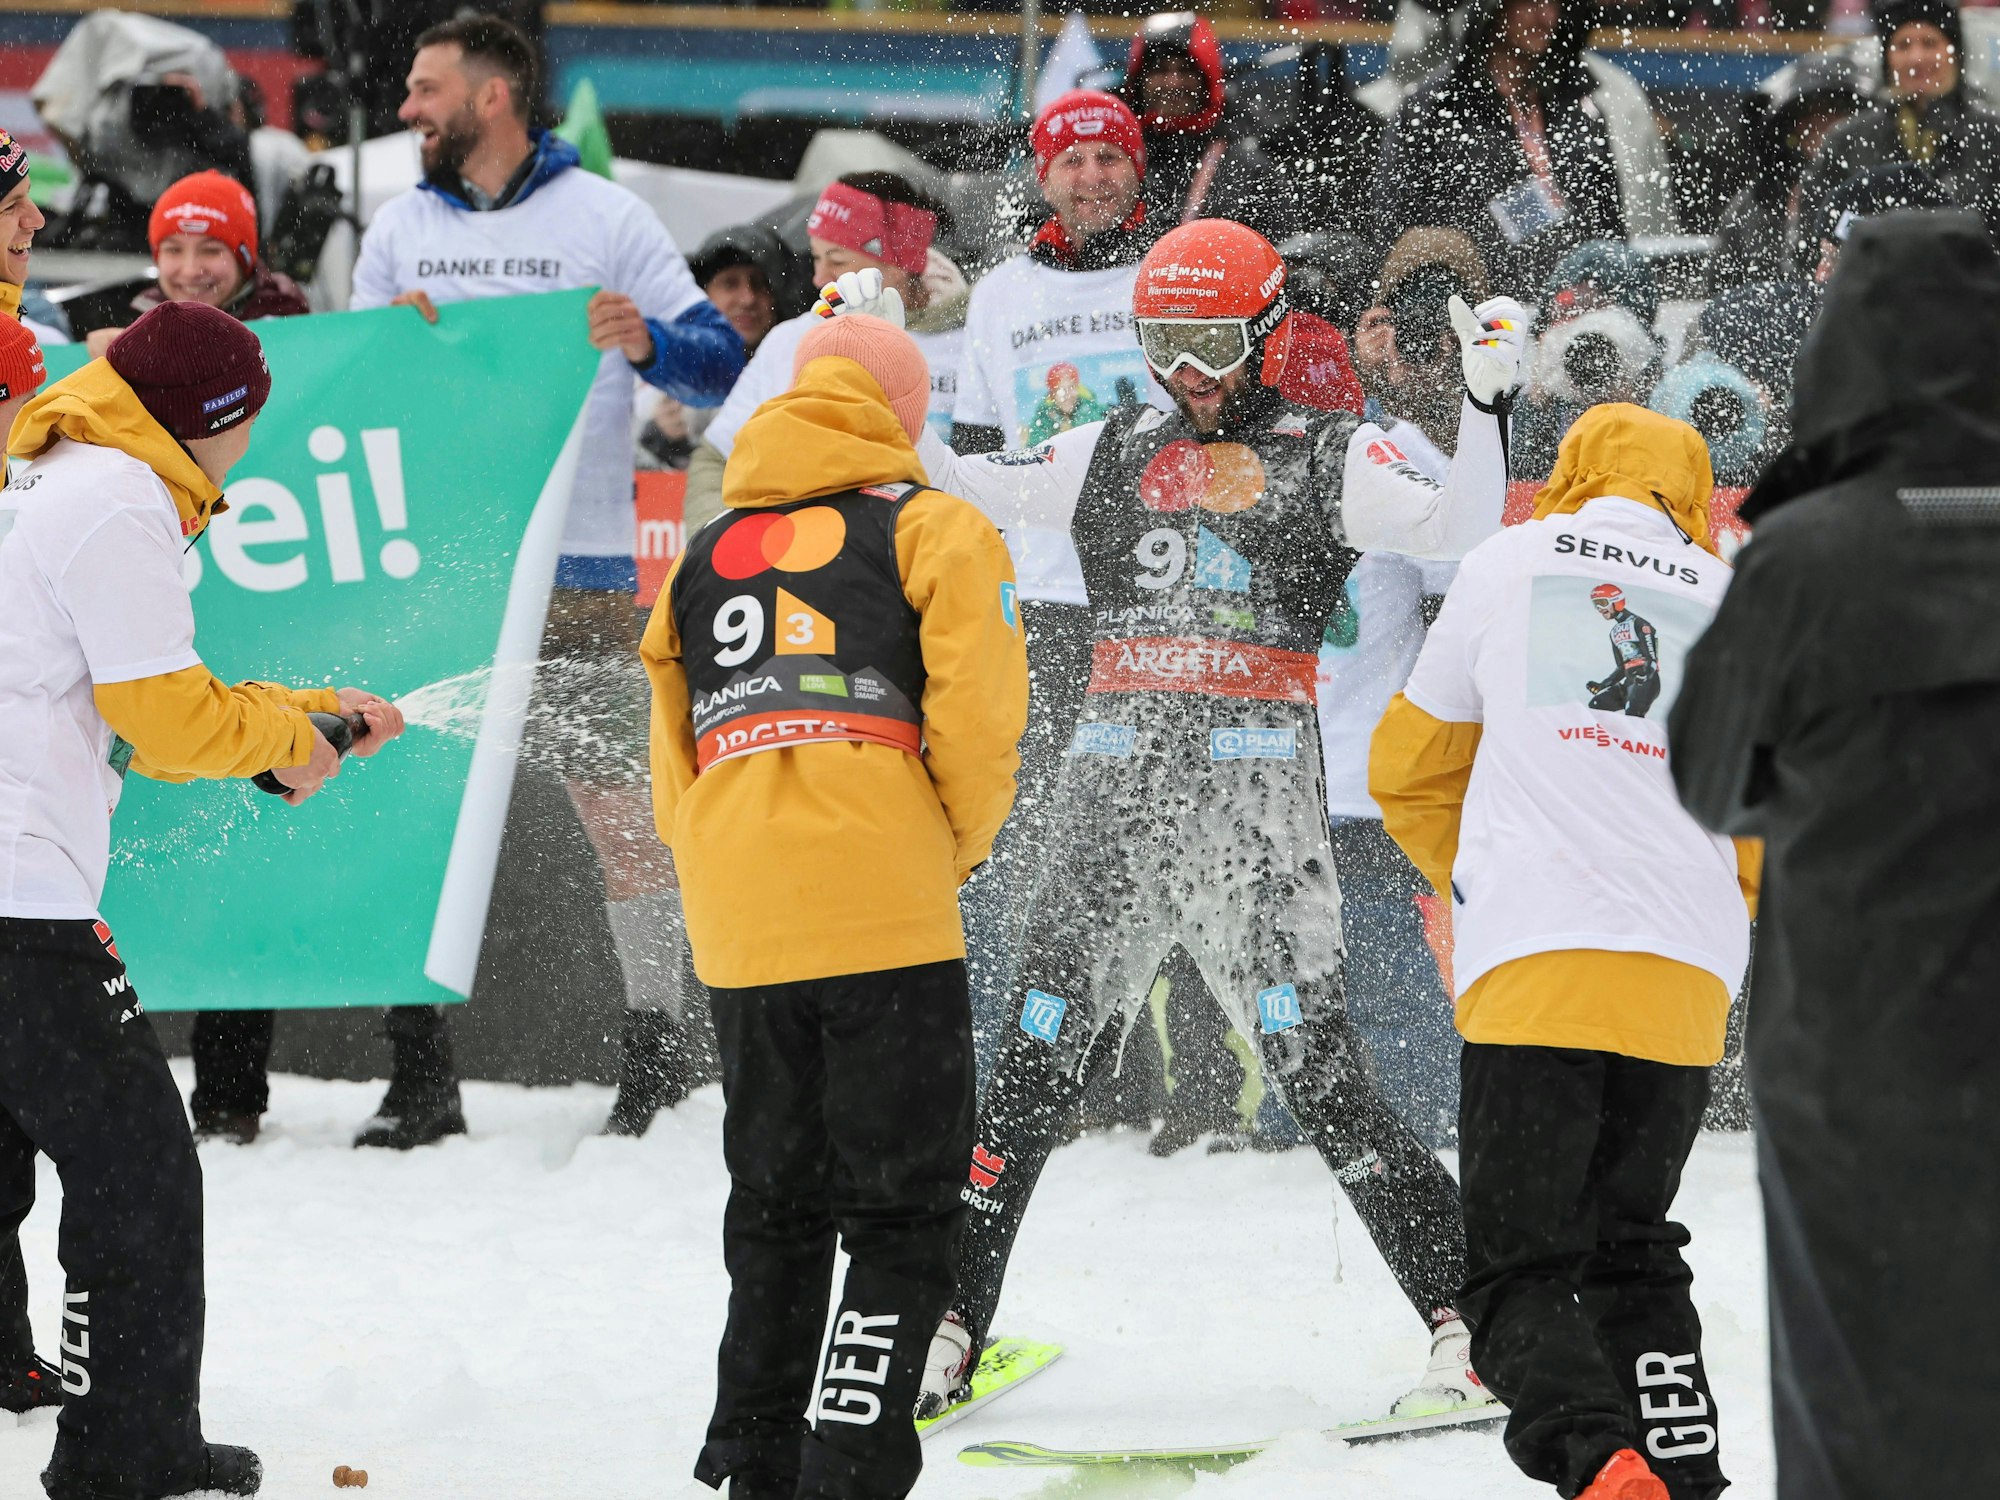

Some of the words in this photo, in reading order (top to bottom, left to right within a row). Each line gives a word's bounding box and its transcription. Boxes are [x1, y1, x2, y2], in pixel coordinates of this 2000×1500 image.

[417, 258, 496, 278] DANKE
[1149, 263, 1225, 282] VIESSMANN
[1258, 264, 1285, 299] uvex
[1147, 286, 1219, 299] Wärmepumpen
[1011, 315, 1082, 349] DANKE
[1252, 294, 1292, 337] uvex
[205, 387, 247, 411] FAMILUX
[219, 407, 245, 426] TERREX
[1134, 527, 1187, 590] 9
[1205, 549, 1236, 586] 4
[1554, 534, 1699, 585] SERVUS
[713, 594, 765, 668] 9
[785, 612, 815, 645] 3
[1096, 605, 1197, 627] PLANICA
[1116, 644, 1251, 678] ARGETA
[692, 675, 783, 724] PLANICA
[1246, 733, 1291, 748] PLAN
[817, 1310, 900, 1426] GER
[1635, 1351, 1717, 1460] GER
